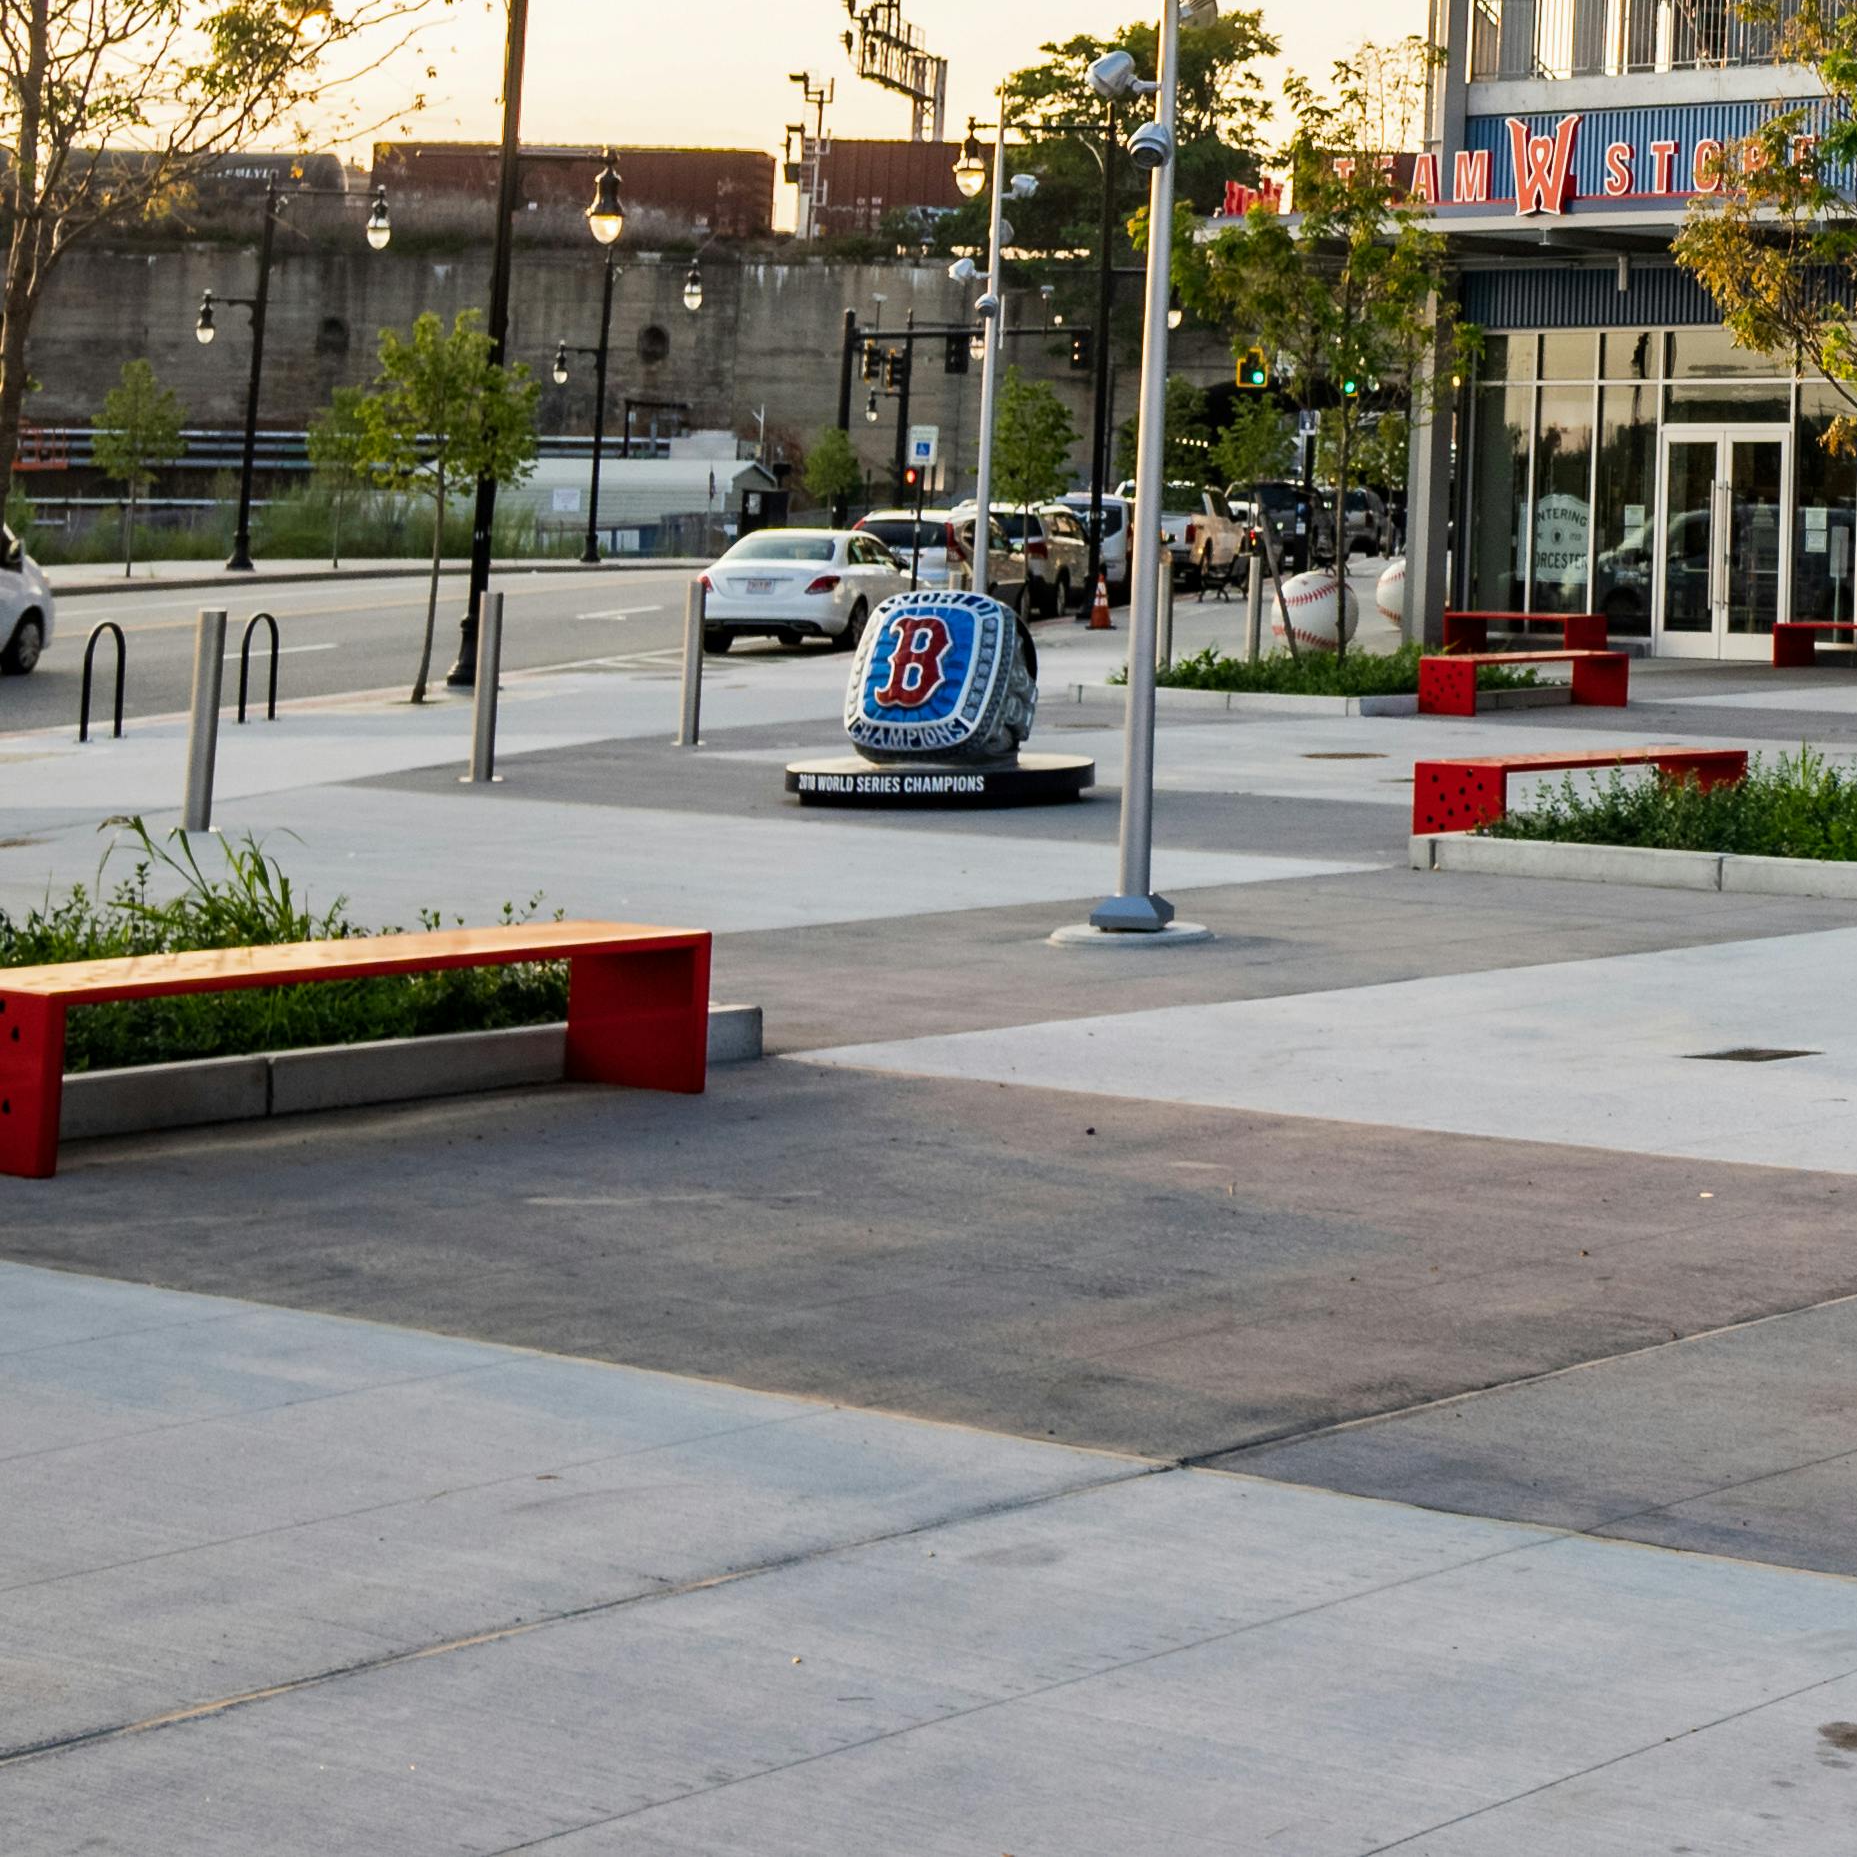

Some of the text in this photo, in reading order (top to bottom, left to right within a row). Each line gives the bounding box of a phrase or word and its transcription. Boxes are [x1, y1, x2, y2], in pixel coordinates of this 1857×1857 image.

[1505, 113, 1584, 217] W
[1536, 508, 1588, 528] NTERING
[1536, 551, 1588, 570] ORCESTER
[880, 592, 1000, 617] WORLD
[874, 615, 953, 709] B
[849, 717, 971, 749] CHAMPIONS
[817, 774, 854, 793] WORLD
[855, 775, 901, 793] SERIES
[903, 774, 985, 793] CHAMPIONS
